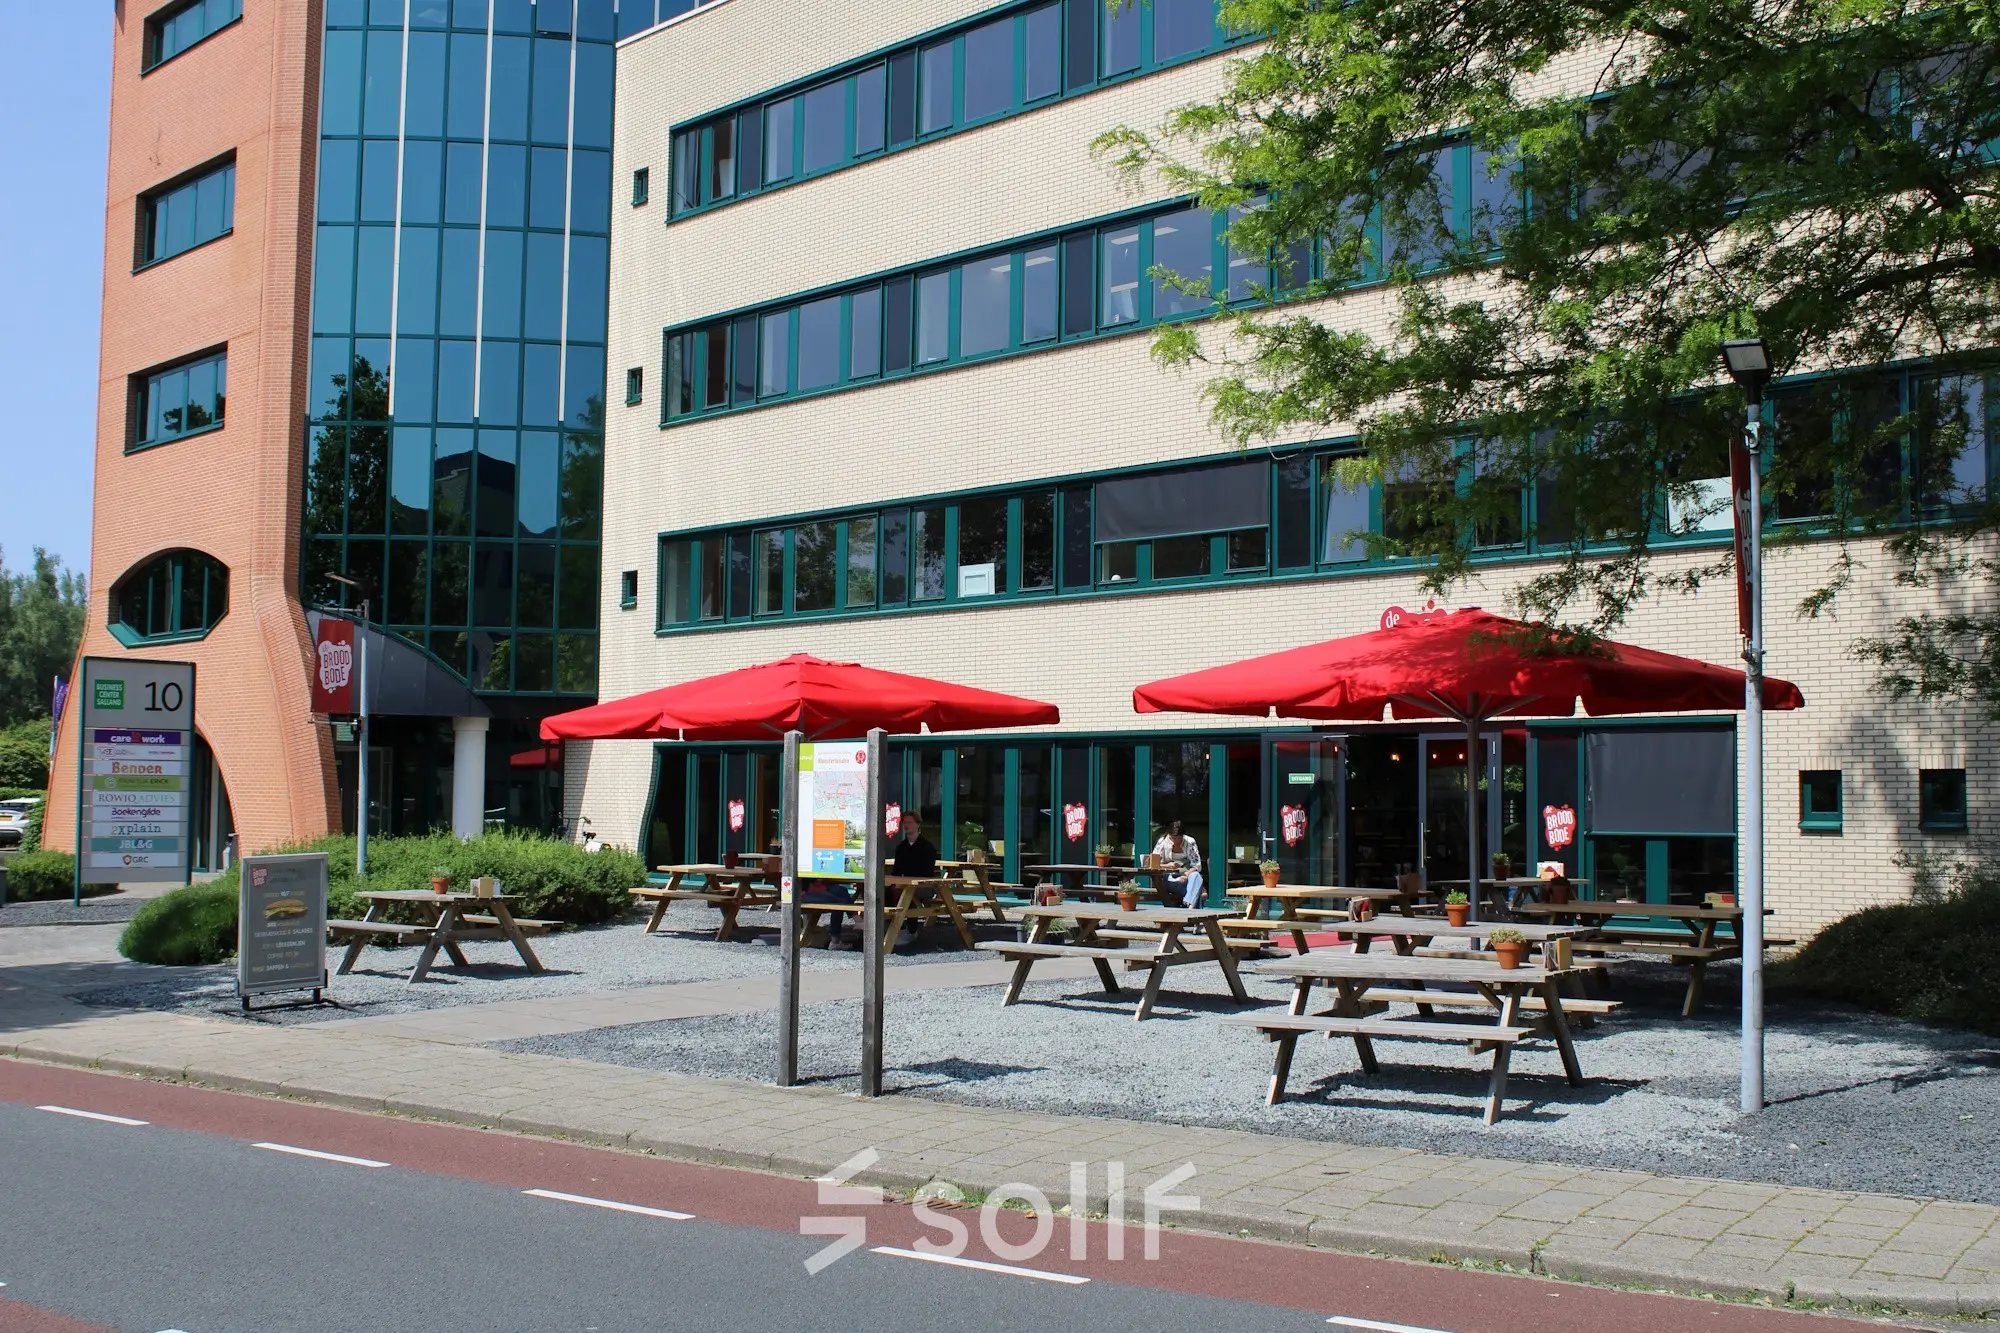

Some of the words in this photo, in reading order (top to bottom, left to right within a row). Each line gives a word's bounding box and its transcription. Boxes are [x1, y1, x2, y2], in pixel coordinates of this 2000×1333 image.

[1385, 610, 1400, 629] de
[323, 650, 350, 668] BROOD
[325, 666, 346, 685] BODE
[96, 683, 122, 691] BUSINESS
[96, 698, 122, 706] SALLAND
[144, 681, 183, 712] 10
[110, 735, 132, 743] care
[141, 734, 165, 743] work
[139, 794, 176, 803] ADVIES
[111, 807, 161, 818] Boekengilde
[1066, 807, 1085, 825] BROOD
[1283, 809, 1306, 828] BROOD
[1546, 810, 1574, 830] BROOD
[111, 823, 162, 836] 2xplain
[1068, 821, 1083, 837] BODE
[1285, 824, 1303, 841] BODE
[1548, 826, 1570, 844] BODE
[119, 839, 153, 849] JBL&G
[132, 856, 149, 864] GRC
